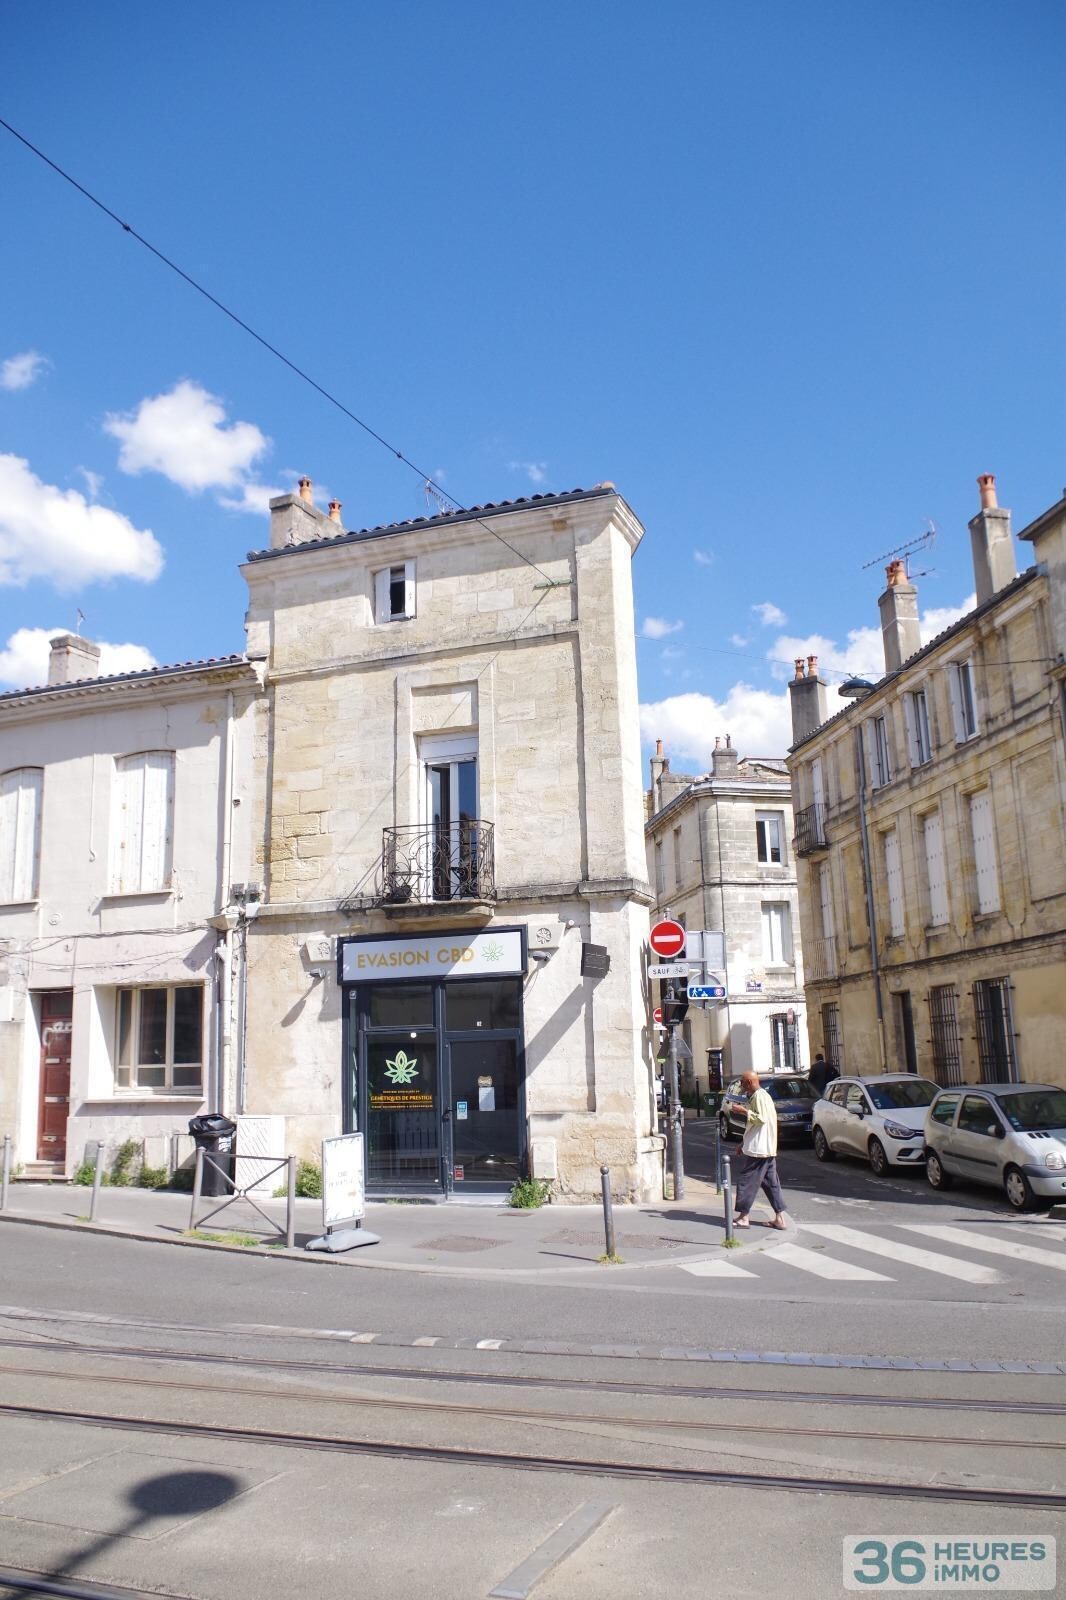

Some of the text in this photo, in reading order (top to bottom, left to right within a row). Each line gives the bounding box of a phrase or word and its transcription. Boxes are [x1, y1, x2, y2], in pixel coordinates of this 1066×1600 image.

[357, 945, 475, 969] EVASION CBD
[652, 967, 670, 975] SAUF
